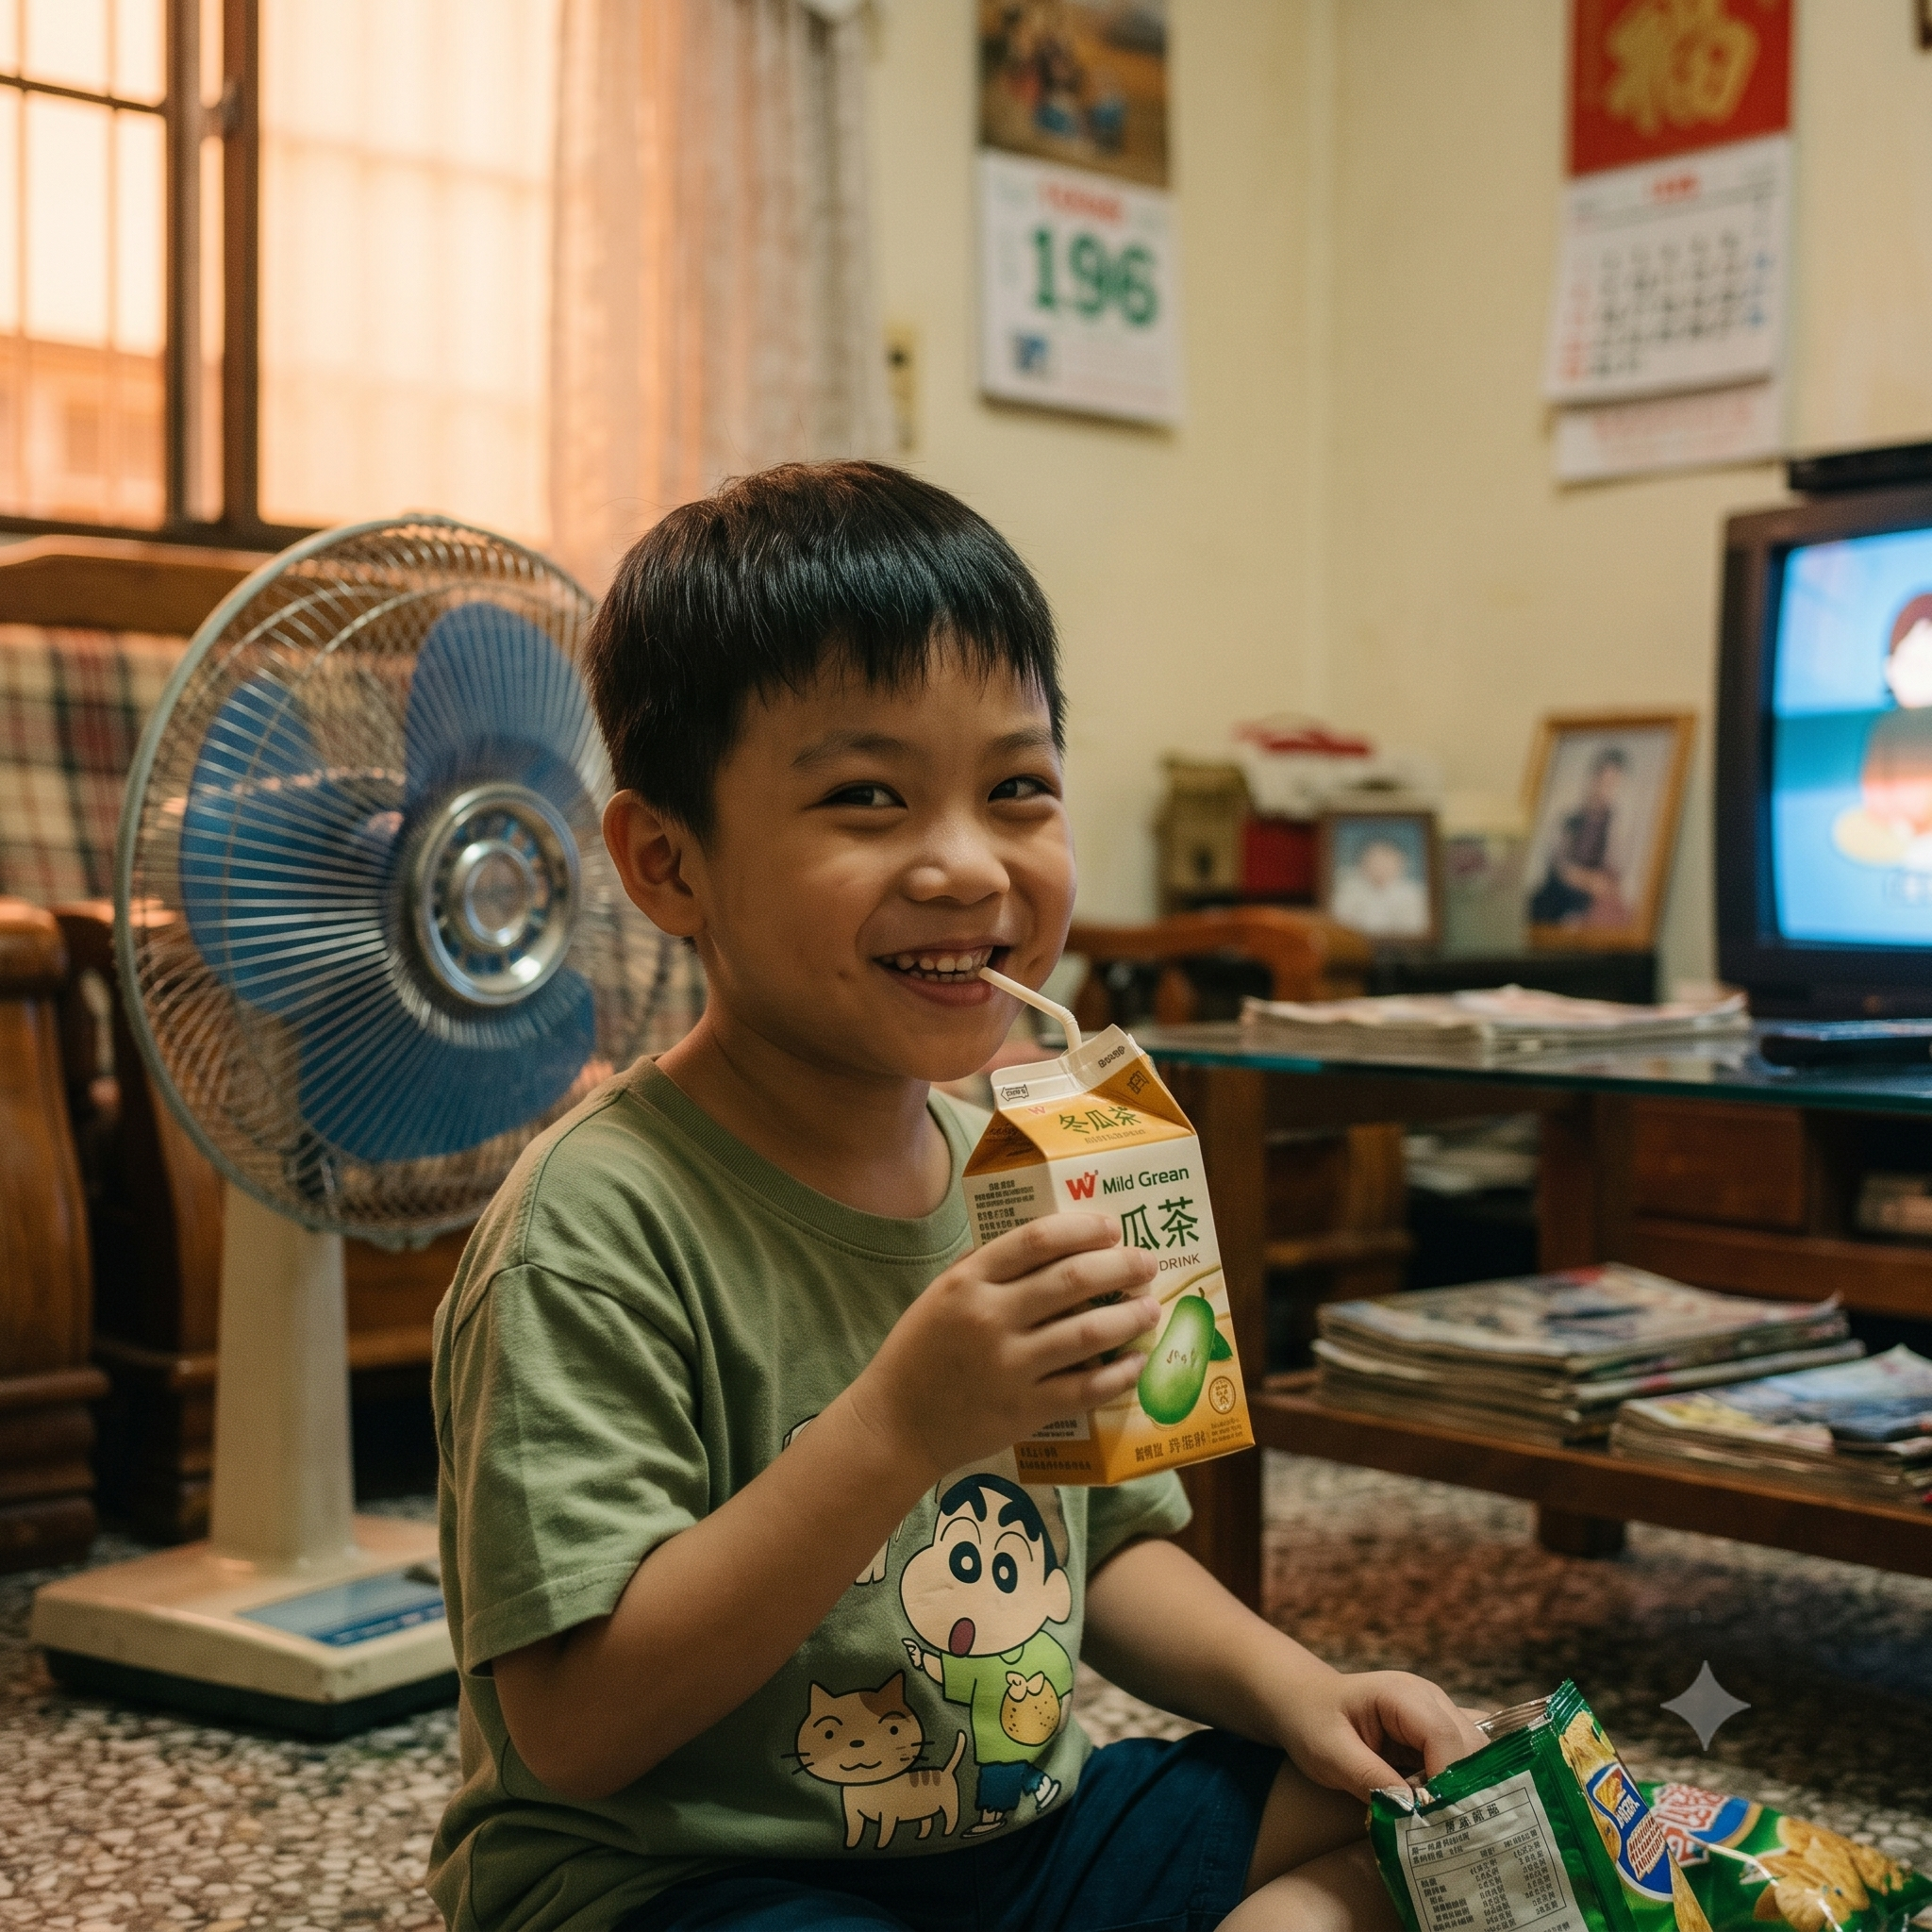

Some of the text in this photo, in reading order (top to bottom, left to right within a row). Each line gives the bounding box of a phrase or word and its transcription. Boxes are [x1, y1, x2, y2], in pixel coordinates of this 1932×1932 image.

[1030, 224, 1159, 331] 196
[1058, 1106, 1141, 1134] 冬瓜茶
[1102, 1174, 1135, 1195] Mild
[1138, 1168, 1190, 1188] Grean
[1158, 1253, 1201, 1272] DRINK
